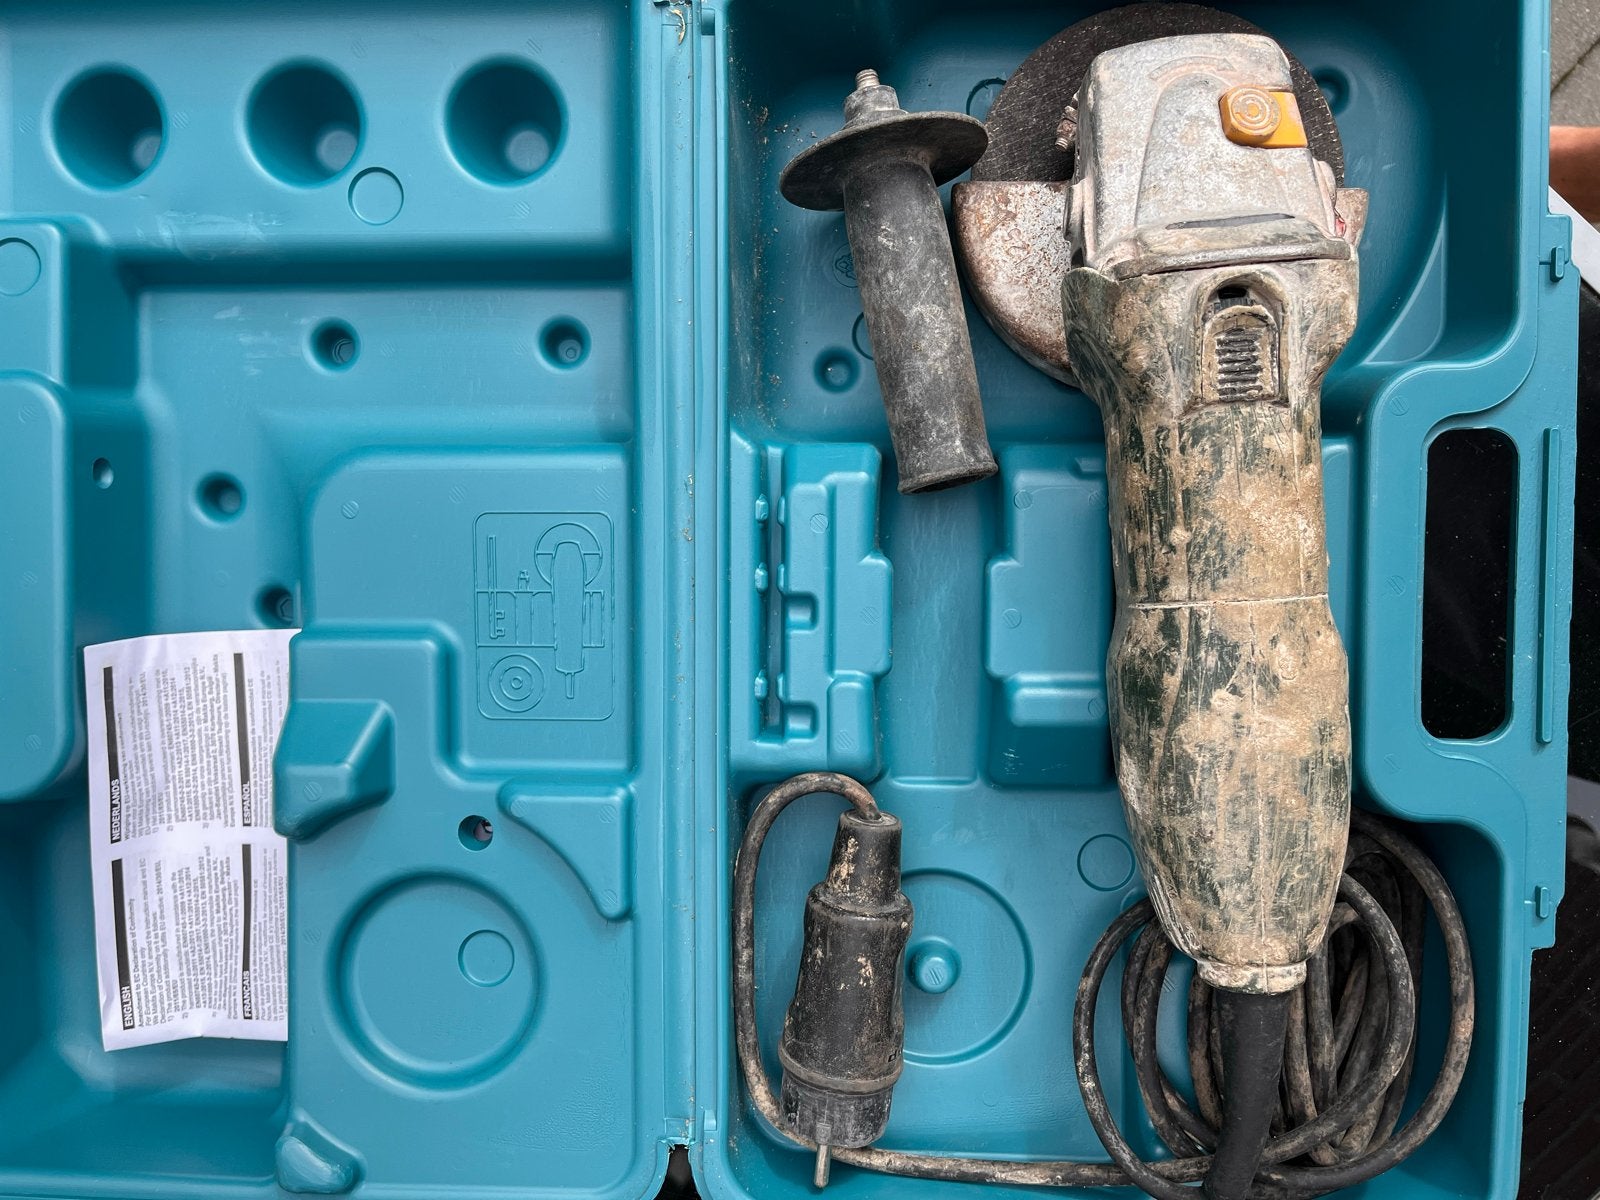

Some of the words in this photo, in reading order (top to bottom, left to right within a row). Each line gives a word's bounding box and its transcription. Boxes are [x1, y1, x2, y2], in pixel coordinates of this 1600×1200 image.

[111, 779, 120, 840] NEDERLANDS
[242, 781, 250, 823] ESPAÑOL
[122, 986, 133, 1026] ENGLISH
